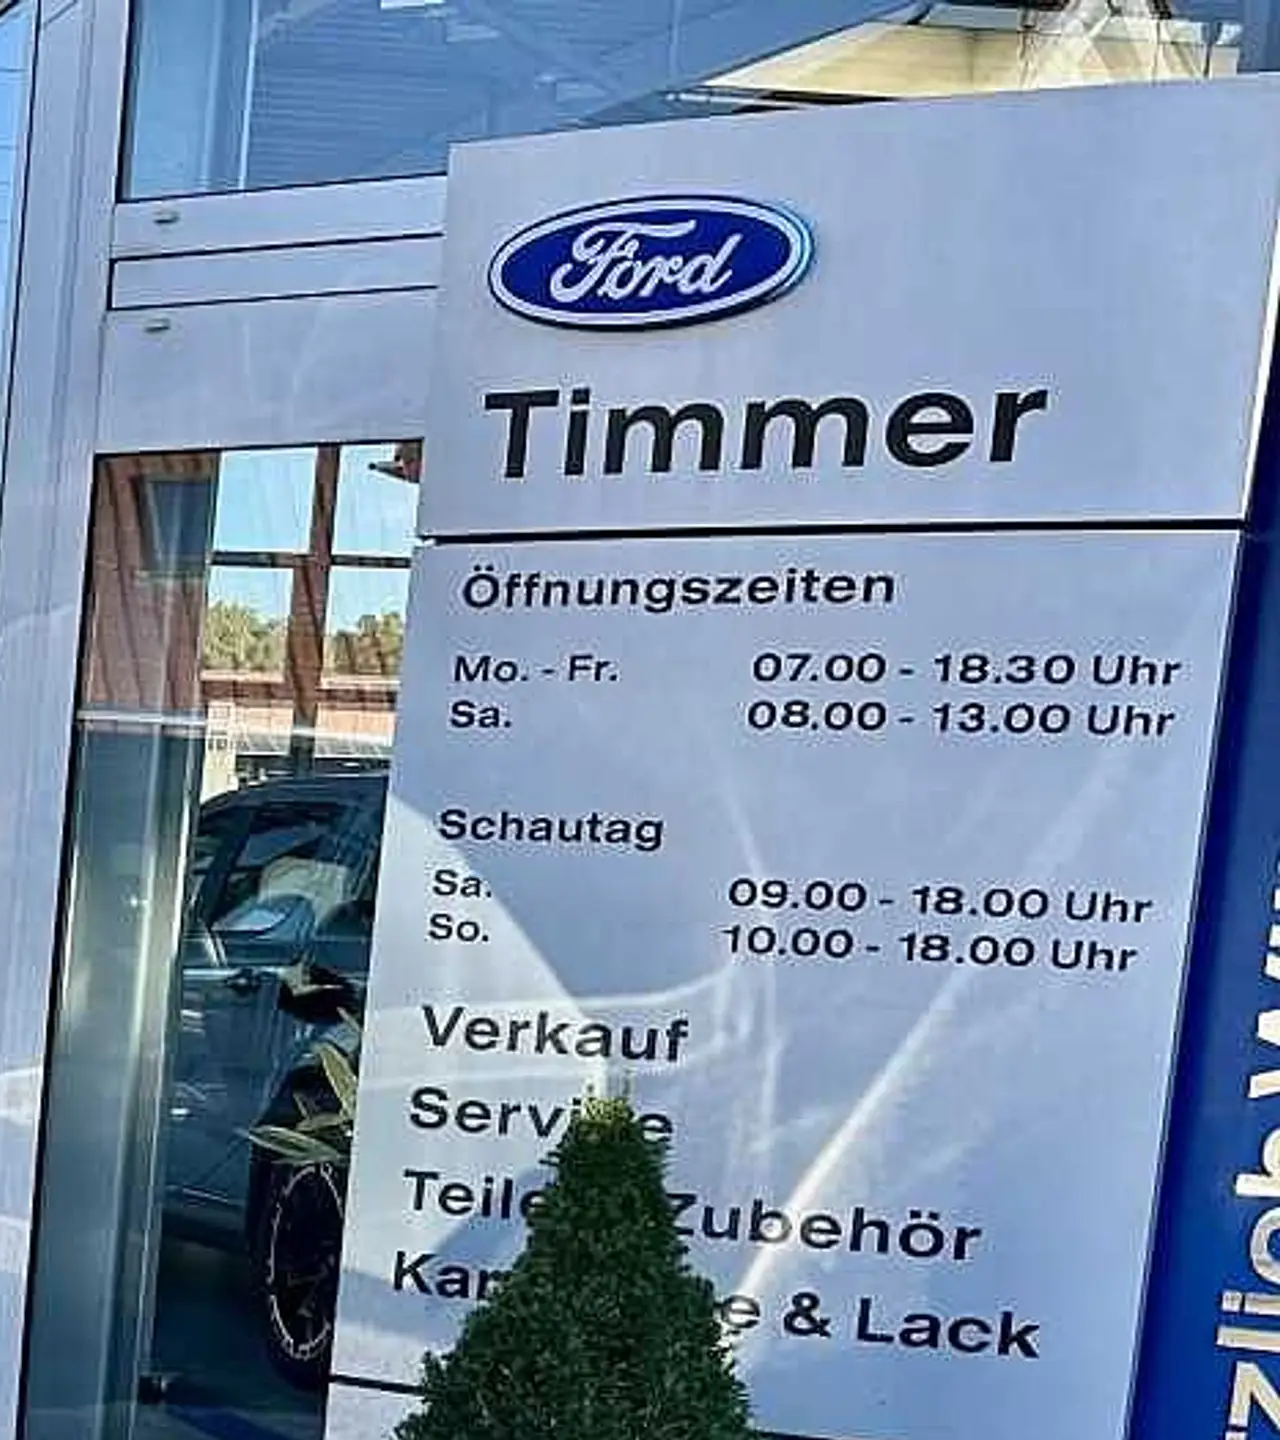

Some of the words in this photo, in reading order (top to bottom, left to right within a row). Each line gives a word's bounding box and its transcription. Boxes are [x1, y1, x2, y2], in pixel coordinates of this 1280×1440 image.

[549, 217, 745, 303] Ford
[485, 388, 1048, 478] Timmer
[463, 565, 893, 613] Öffnungszeiten
[455, 656, 528, 682] Mo.
[569, 655, 617, 681] Fr.
[754, 653, 885, 682] 07.00
[935, 654, 1075, 684] 18.30
[1094, 656, 1181, 685] Uhr
[451, 700, 511, 728] Sa.
[749, 700, 886, 730] 08.00
[934, 703, 1070, 733] 13.00
[1088, 705, 1174, 735] Uhr
[439, 809, 663, 851] Schautag
[434, 870, 491, 897] Sa.
[729, 879, 866, 911] 09.00
[913, 886, 1048, 919] 18.00
[1066, 892, 1152, 922] Uhr
[429, 914, 488, 941] So.
[723, 925, 853, 958] 10.00
[900, 933, 1034, 966] 18.00
[1052, 940, 1137, 971] Uhr
[423, 1006, 688, 1061] Verkauf
[410, 1086, 673, 1144] Servie
[667, 1193, 982, 1261] Zubehör
[784, 1293, 831, 1338] &
[857, 1298, 1039, 1358] Lack
